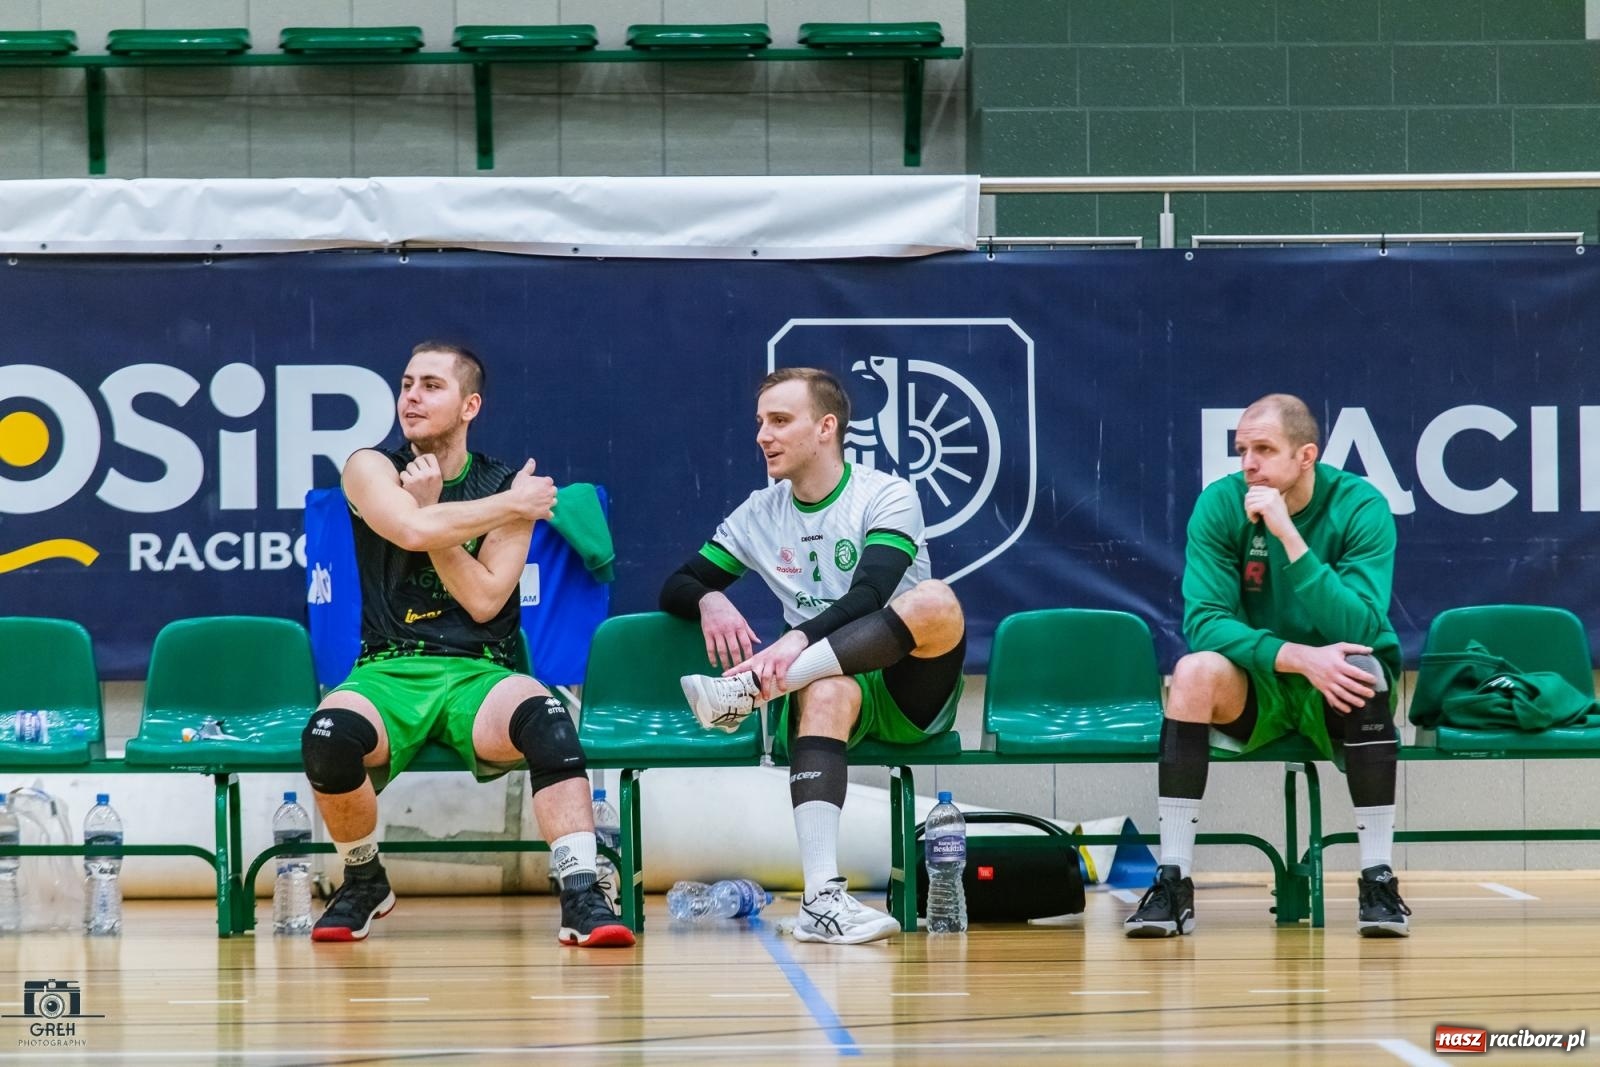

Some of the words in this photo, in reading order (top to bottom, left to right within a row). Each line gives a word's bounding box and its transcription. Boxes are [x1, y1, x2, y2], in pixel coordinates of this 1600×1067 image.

[0, 363, 396, 514] OSiR
[1201, 405, 1600, 515] ACI
[809, 551, 822, 582] 2
